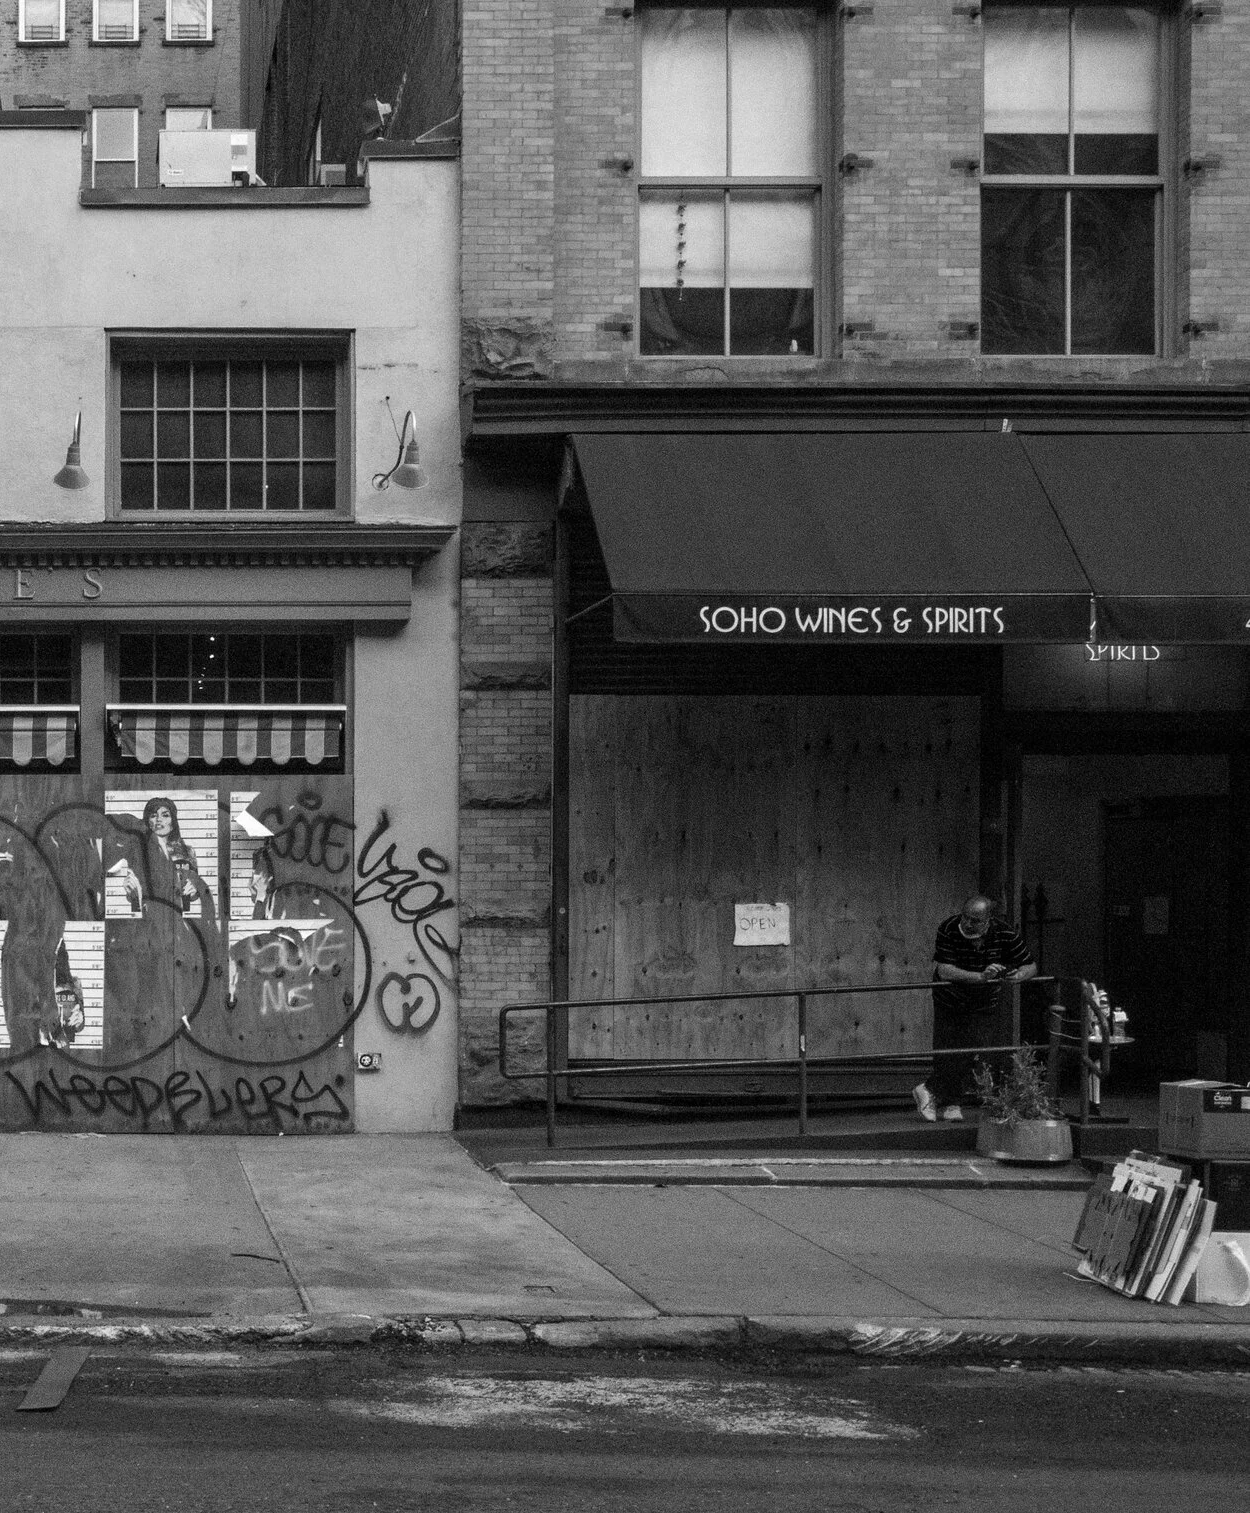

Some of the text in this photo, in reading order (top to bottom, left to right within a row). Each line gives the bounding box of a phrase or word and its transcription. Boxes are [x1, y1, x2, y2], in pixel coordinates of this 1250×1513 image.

[699, 605, 1005, 634] SOHO WINES & SPIRITS
[739, 917, 776, 931] OPEN
